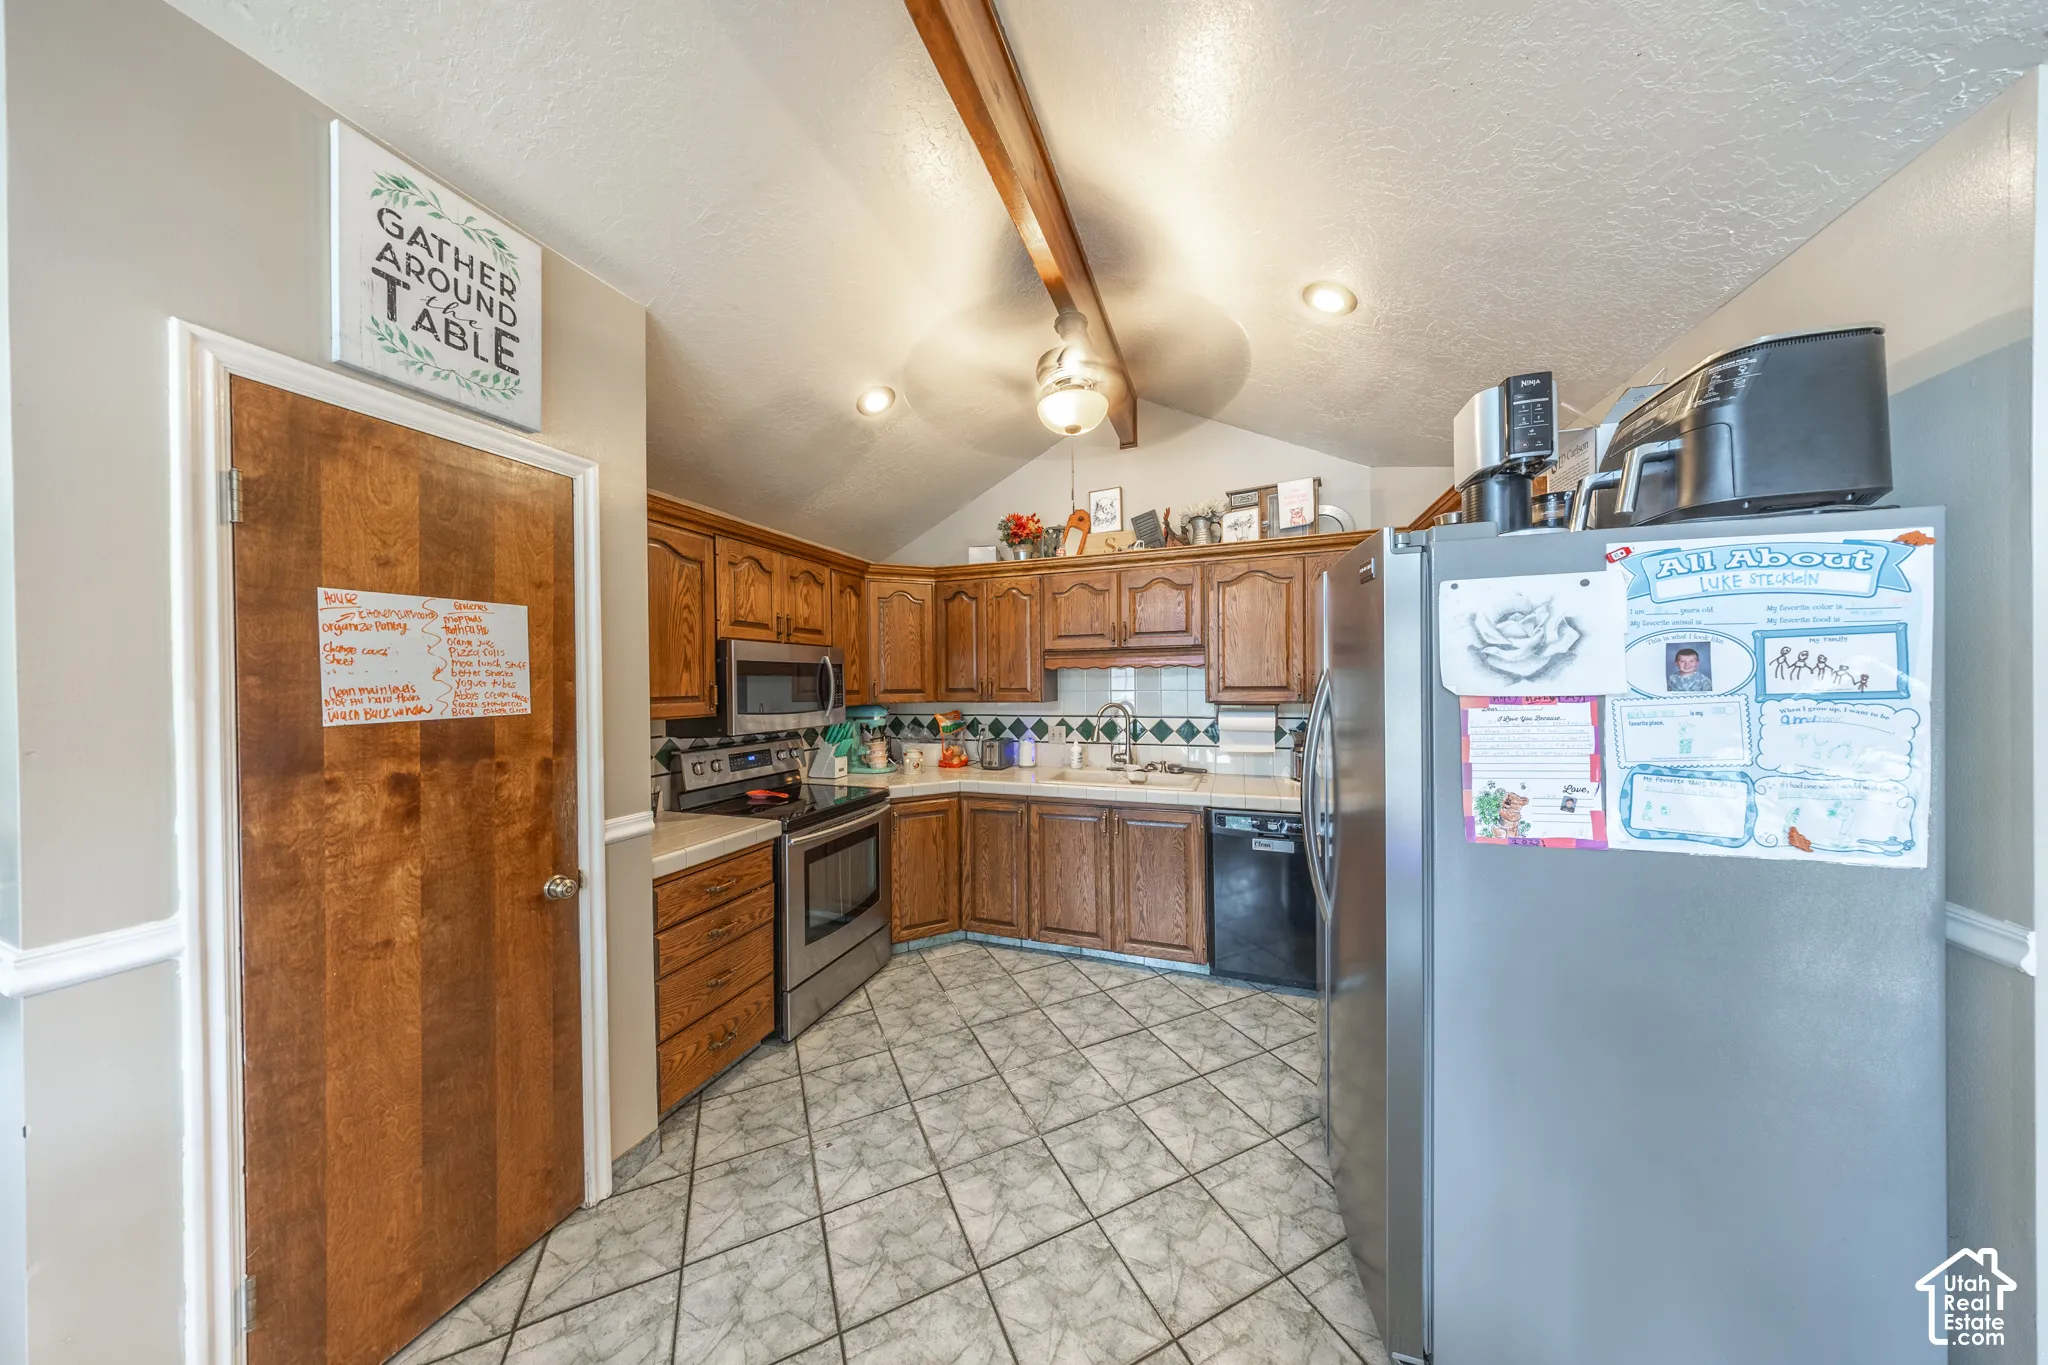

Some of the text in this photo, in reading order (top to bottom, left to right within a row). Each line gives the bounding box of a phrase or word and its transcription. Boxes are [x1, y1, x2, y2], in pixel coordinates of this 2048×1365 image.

[376, 207, 516, 303] GATHER
[375, 242, 518, 328] AROUND
[421, 295, 483, 330] the
[372, 266, 520, 376] TABLE
[1656, 547, 1874, 579] All About
[1700, 574, 1742, 592] LUKE
[1680, 608, 1700, 616] years
[1766, 604, 1778, 613] My
[1812, 603, 1834, 611] color
[1630, 620, 1641, 628] My
[1766, 616, 1778, 625] My
[1779, 616, 1811, 624] favorite
[1779, 706, 1801, 714] When
[1849, 709, 1869, 717] want
[1562, 784, 1590, 795] Love,
[1790, 781, 1803, 789] had
